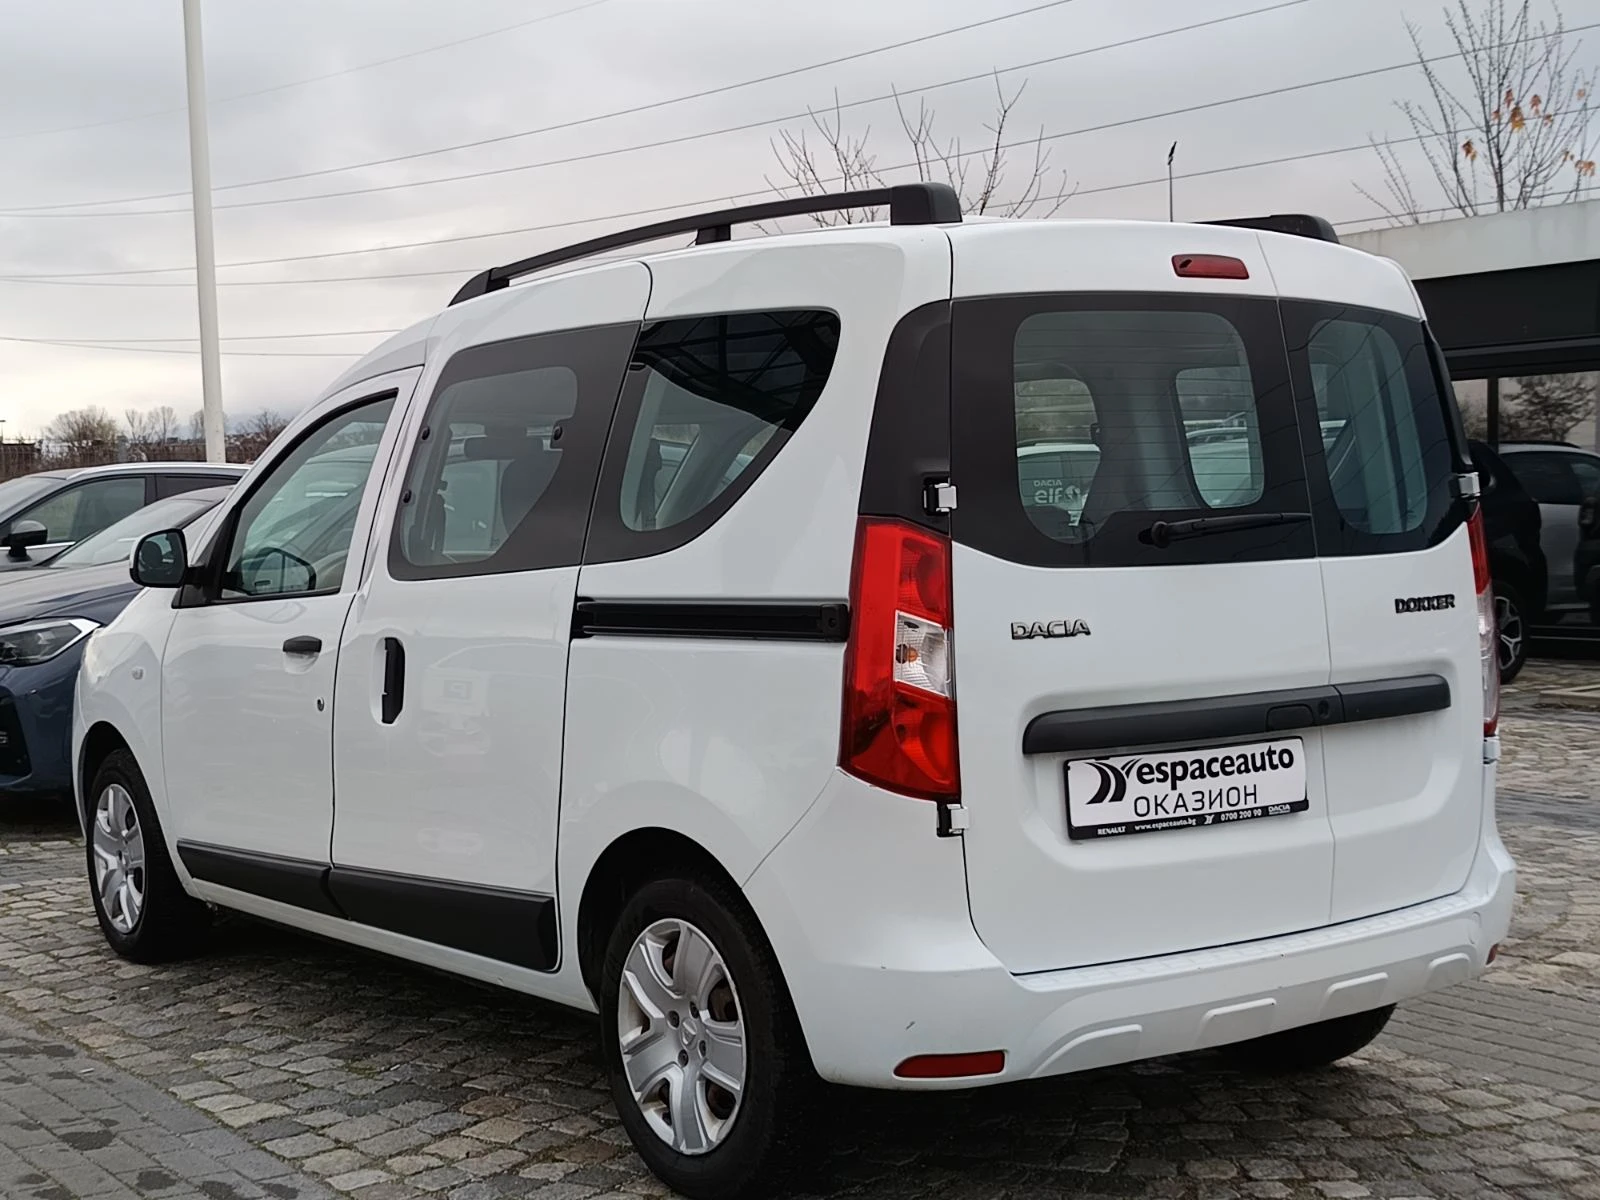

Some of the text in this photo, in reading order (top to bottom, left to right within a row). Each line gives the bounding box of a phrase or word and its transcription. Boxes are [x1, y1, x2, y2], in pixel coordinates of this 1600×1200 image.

[1033, 479, 1063, 487] DACIA
[1034, 487, 1063, 504] elf
[1394, 594, 1456, 614] DOKKER
[1010, 619, 1092, 640] DACIA
[1136, 745, 1295, 791] espaceauto
[1133, 784, 1258, 817] ОКАЗИОН
[1097, 825, 1127, 835] RENAULT
[1134, 817, 1197, 831] www.espaceauto.bg
[1220, 812, 1238, 822] 0700
[1239, 809, 1253, 819] 200
[1268, 804, 1291, 812] DACIA
